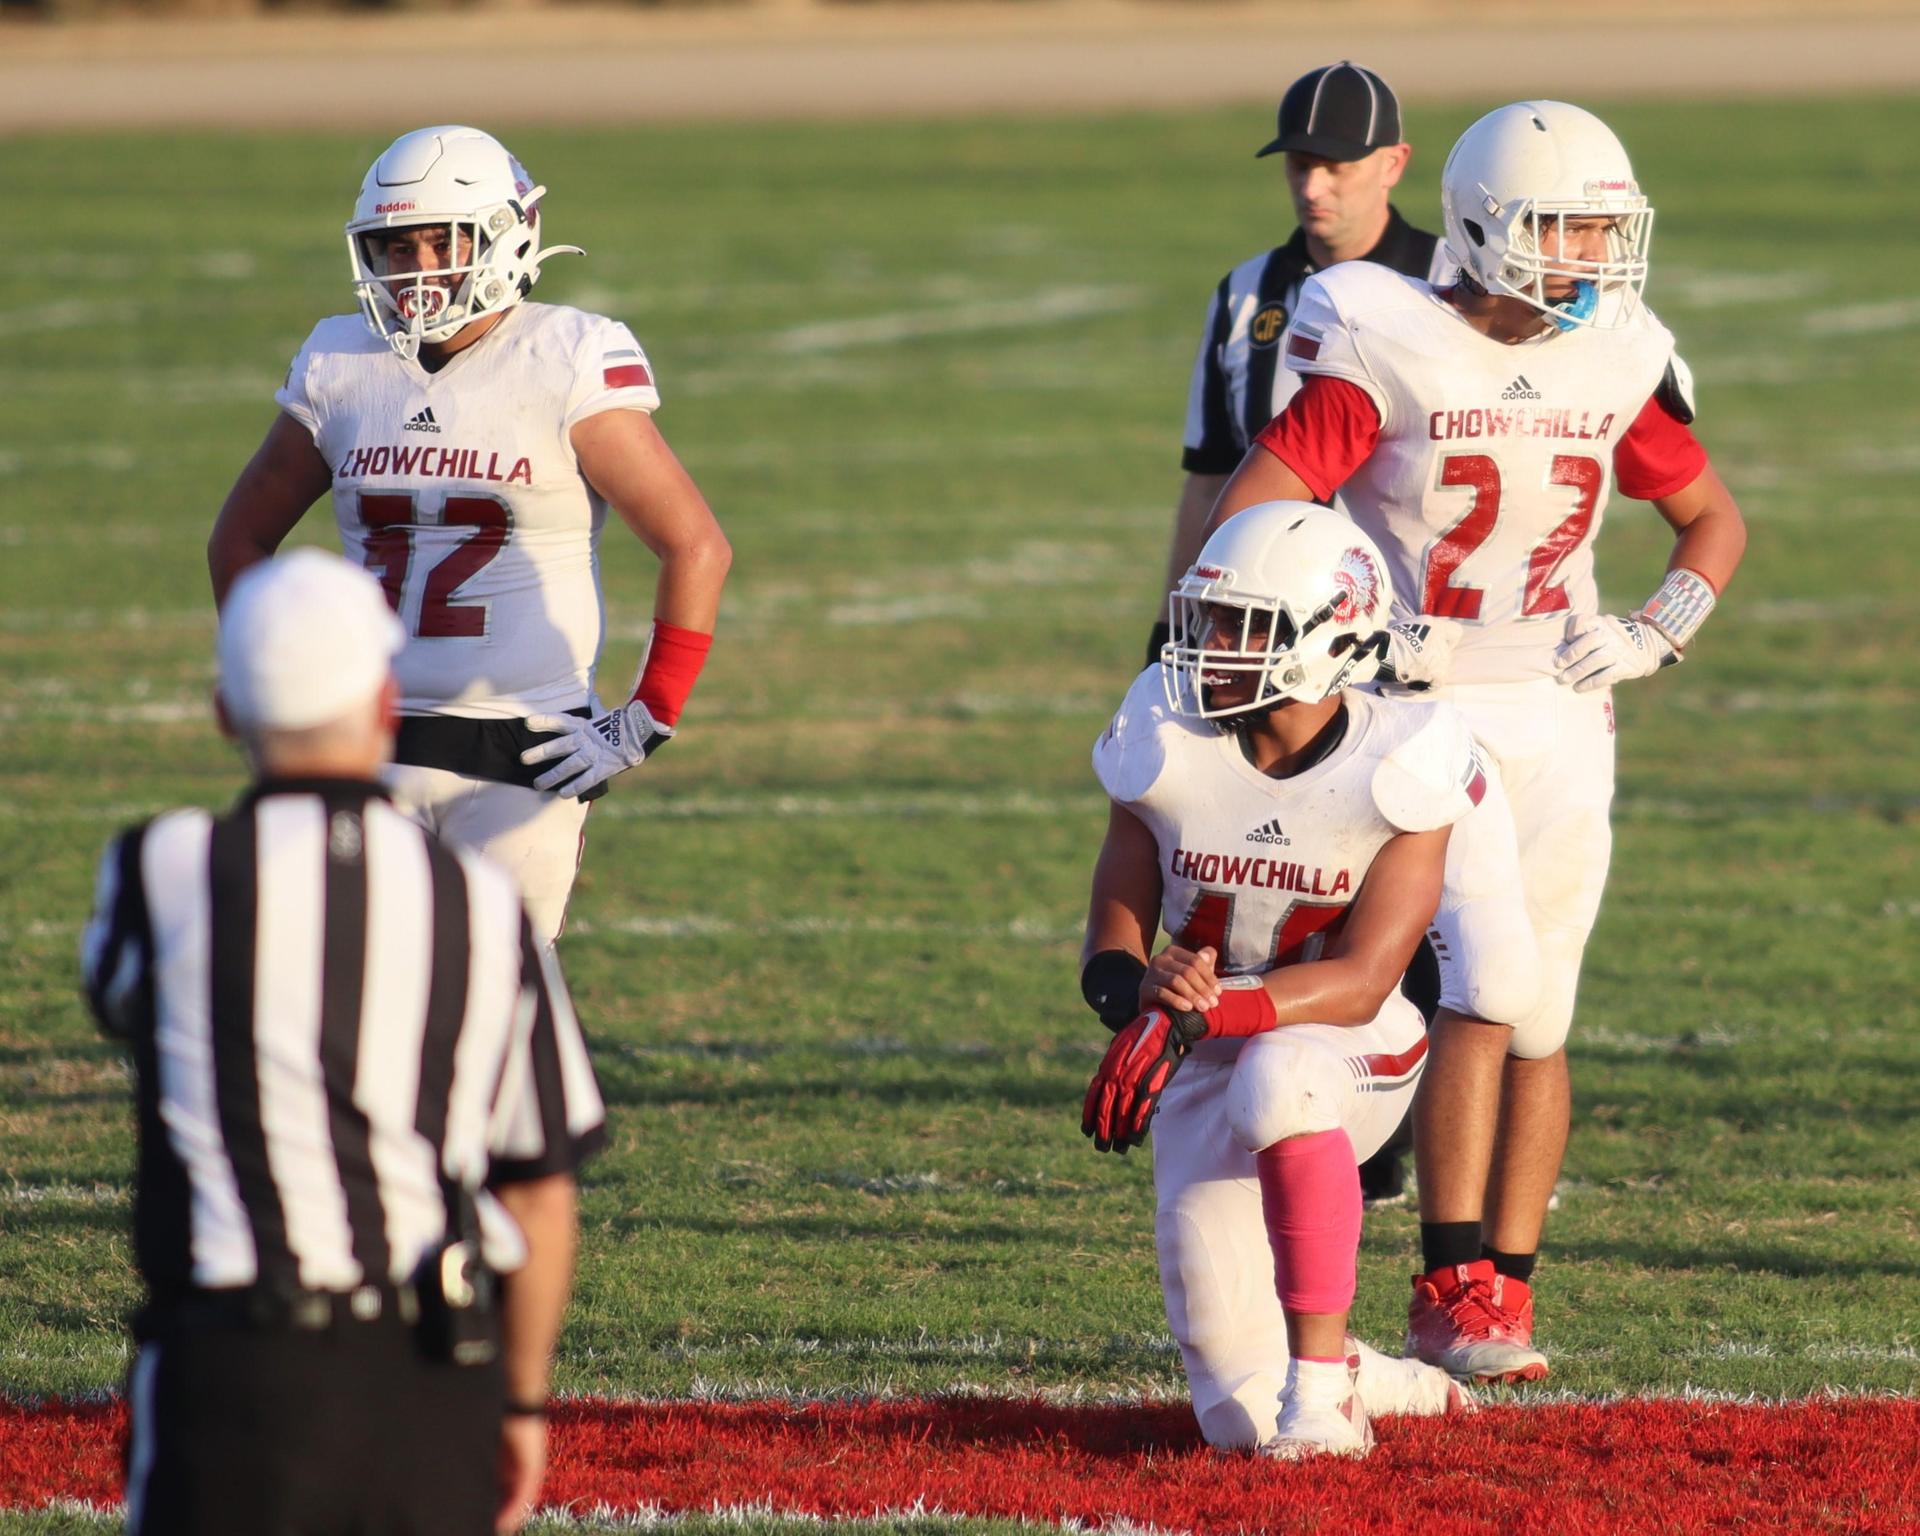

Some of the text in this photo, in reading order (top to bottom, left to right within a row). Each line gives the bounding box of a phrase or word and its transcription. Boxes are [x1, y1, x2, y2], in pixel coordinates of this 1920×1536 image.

[1501, 388, 1541, 400] adidas
[404, 422, 441, 433] adidas
[1429, 407, 1615, 441] CHOWCHILLA
[338, 446, 532, 485] CHOWCHILLA
[1418, 449, 1605, 624] 22
[1246, 833, 1291, 846] adidas
[1171, 848, 1350, 896] CHOWCHILLA
